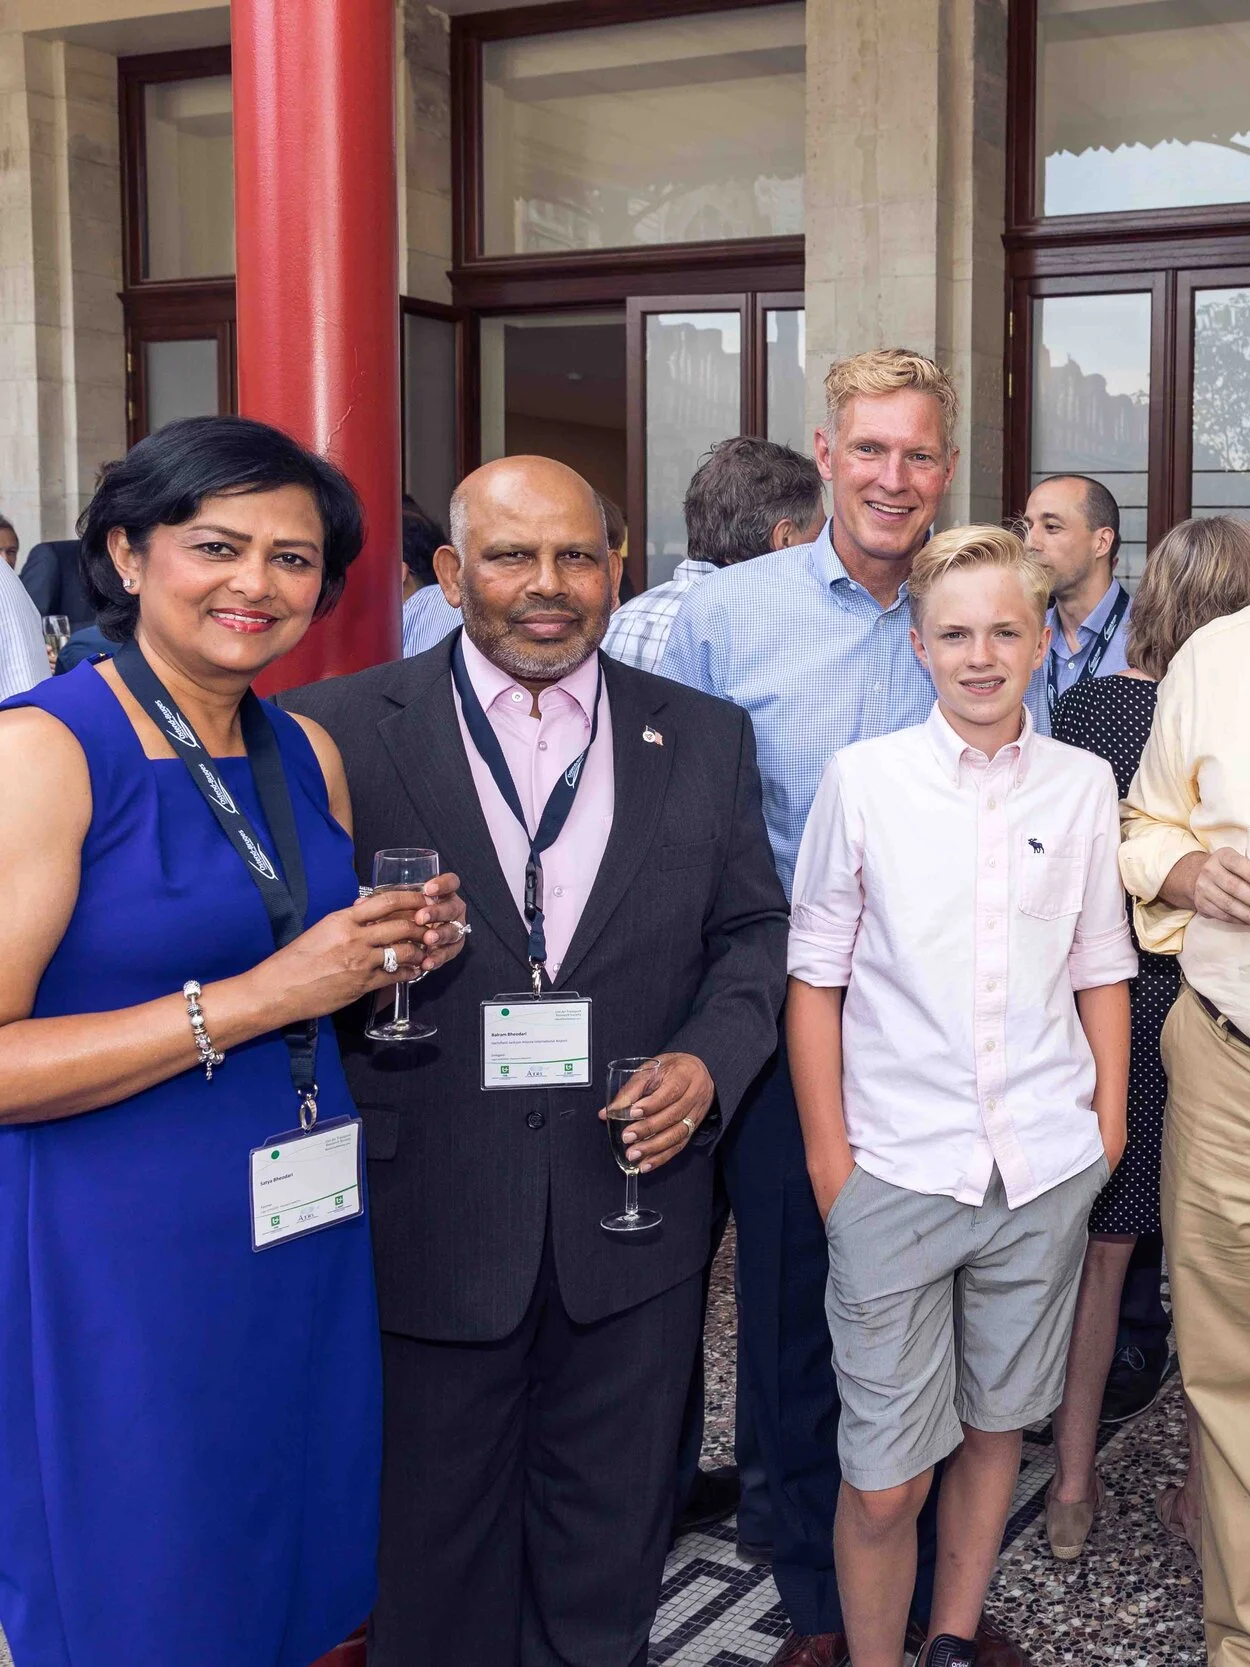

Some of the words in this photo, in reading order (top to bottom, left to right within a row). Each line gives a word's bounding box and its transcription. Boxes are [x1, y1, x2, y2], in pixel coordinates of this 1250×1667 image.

[154, 699, 186, 740] Ostend-Bruges
[198, 763, 227, 806] Ostend-Bruges
[238, 829, 267, 872] Ostend-Bruges
